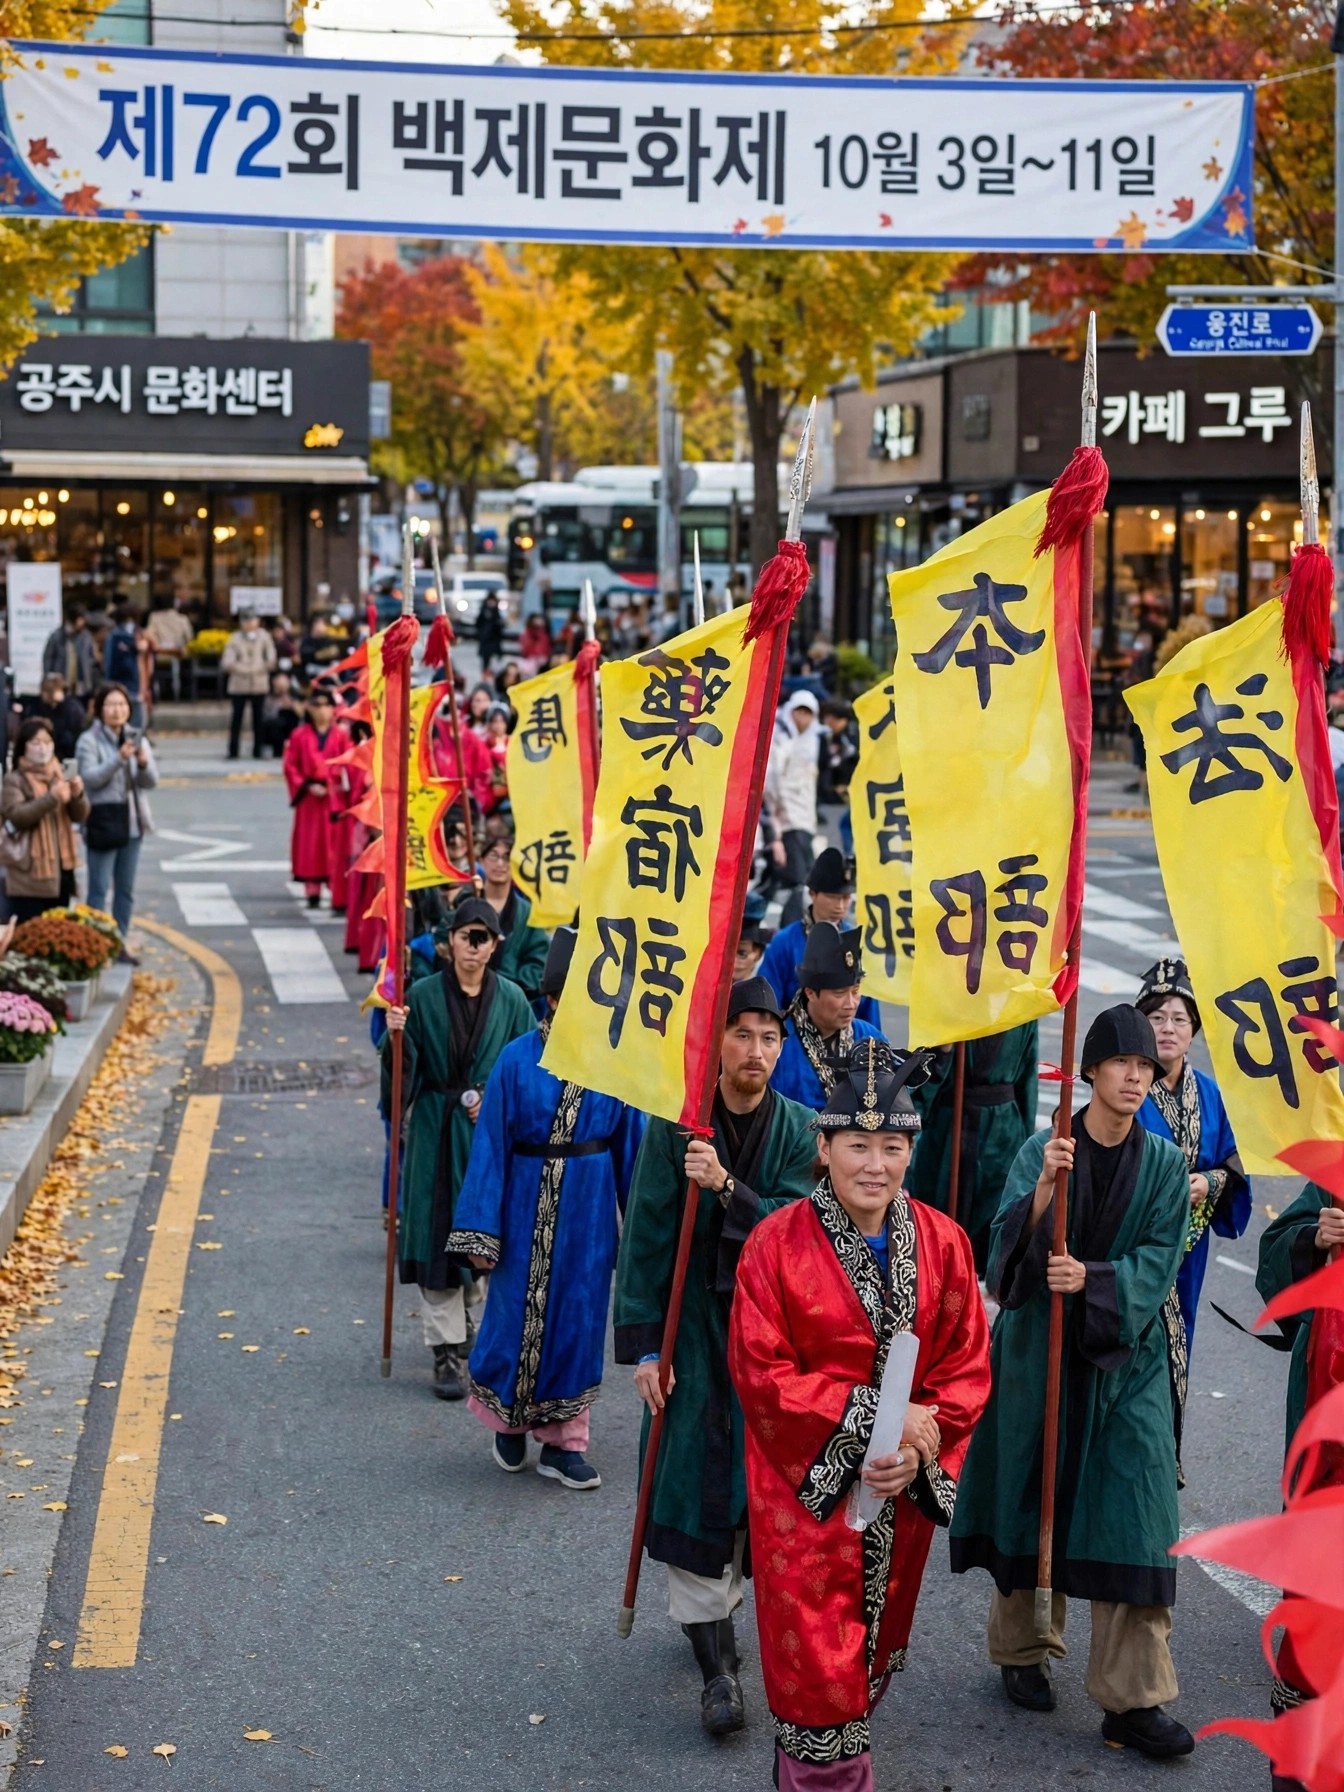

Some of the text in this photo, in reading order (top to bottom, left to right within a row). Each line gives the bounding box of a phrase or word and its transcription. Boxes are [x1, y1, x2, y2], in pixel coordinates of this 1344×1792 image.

[97, 84, 1157, 206] 제72회 백제문화제 10월 3일~11일
[16, 363, 293, 417] 공주시 문화센터
[1101, 386, 1293, 445] 카페 그루
